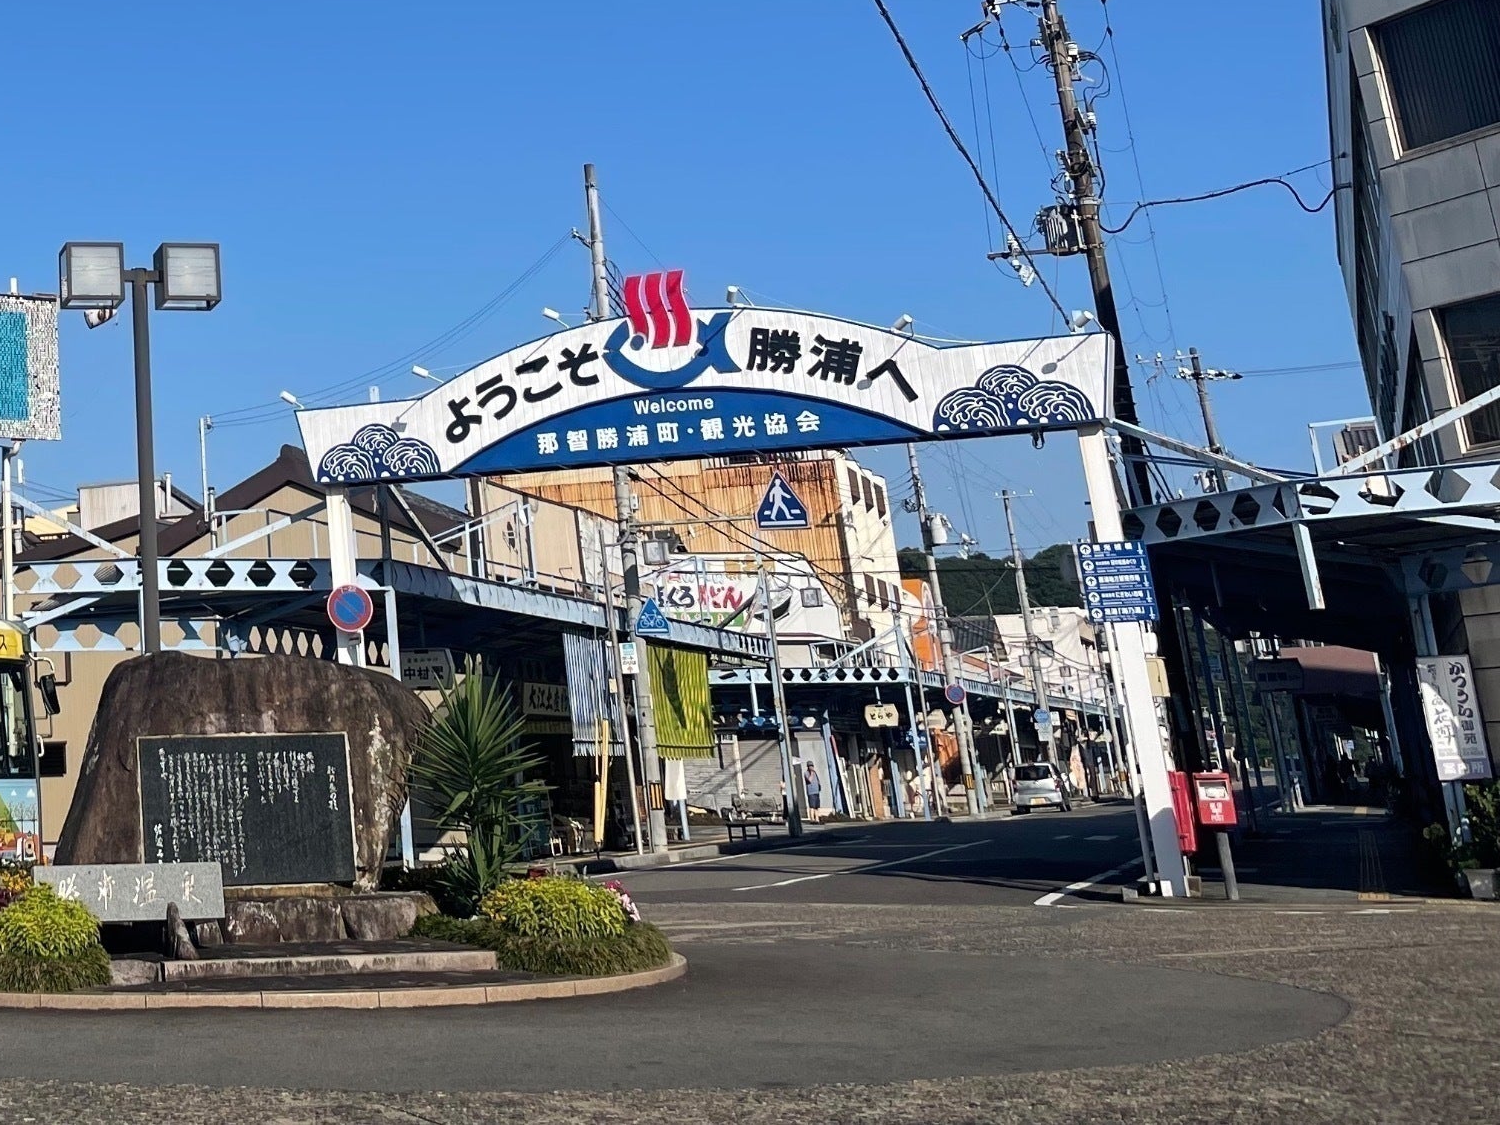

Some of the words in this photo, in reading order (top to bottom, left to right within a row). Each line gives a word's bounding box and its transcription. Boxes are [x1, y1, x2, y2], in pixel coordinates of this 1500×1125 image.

[446, 343, 599, 443] ようこそ
[746, 327, 918, 403] 勝浦へ
[633, 397, 714, 415] Welcome
[537, 410, 821, 455] 那智勝浦町・観光協会
[870, 712, 894, 721] とらや
[1448, 661, 1478, 744] かつうら御苑
